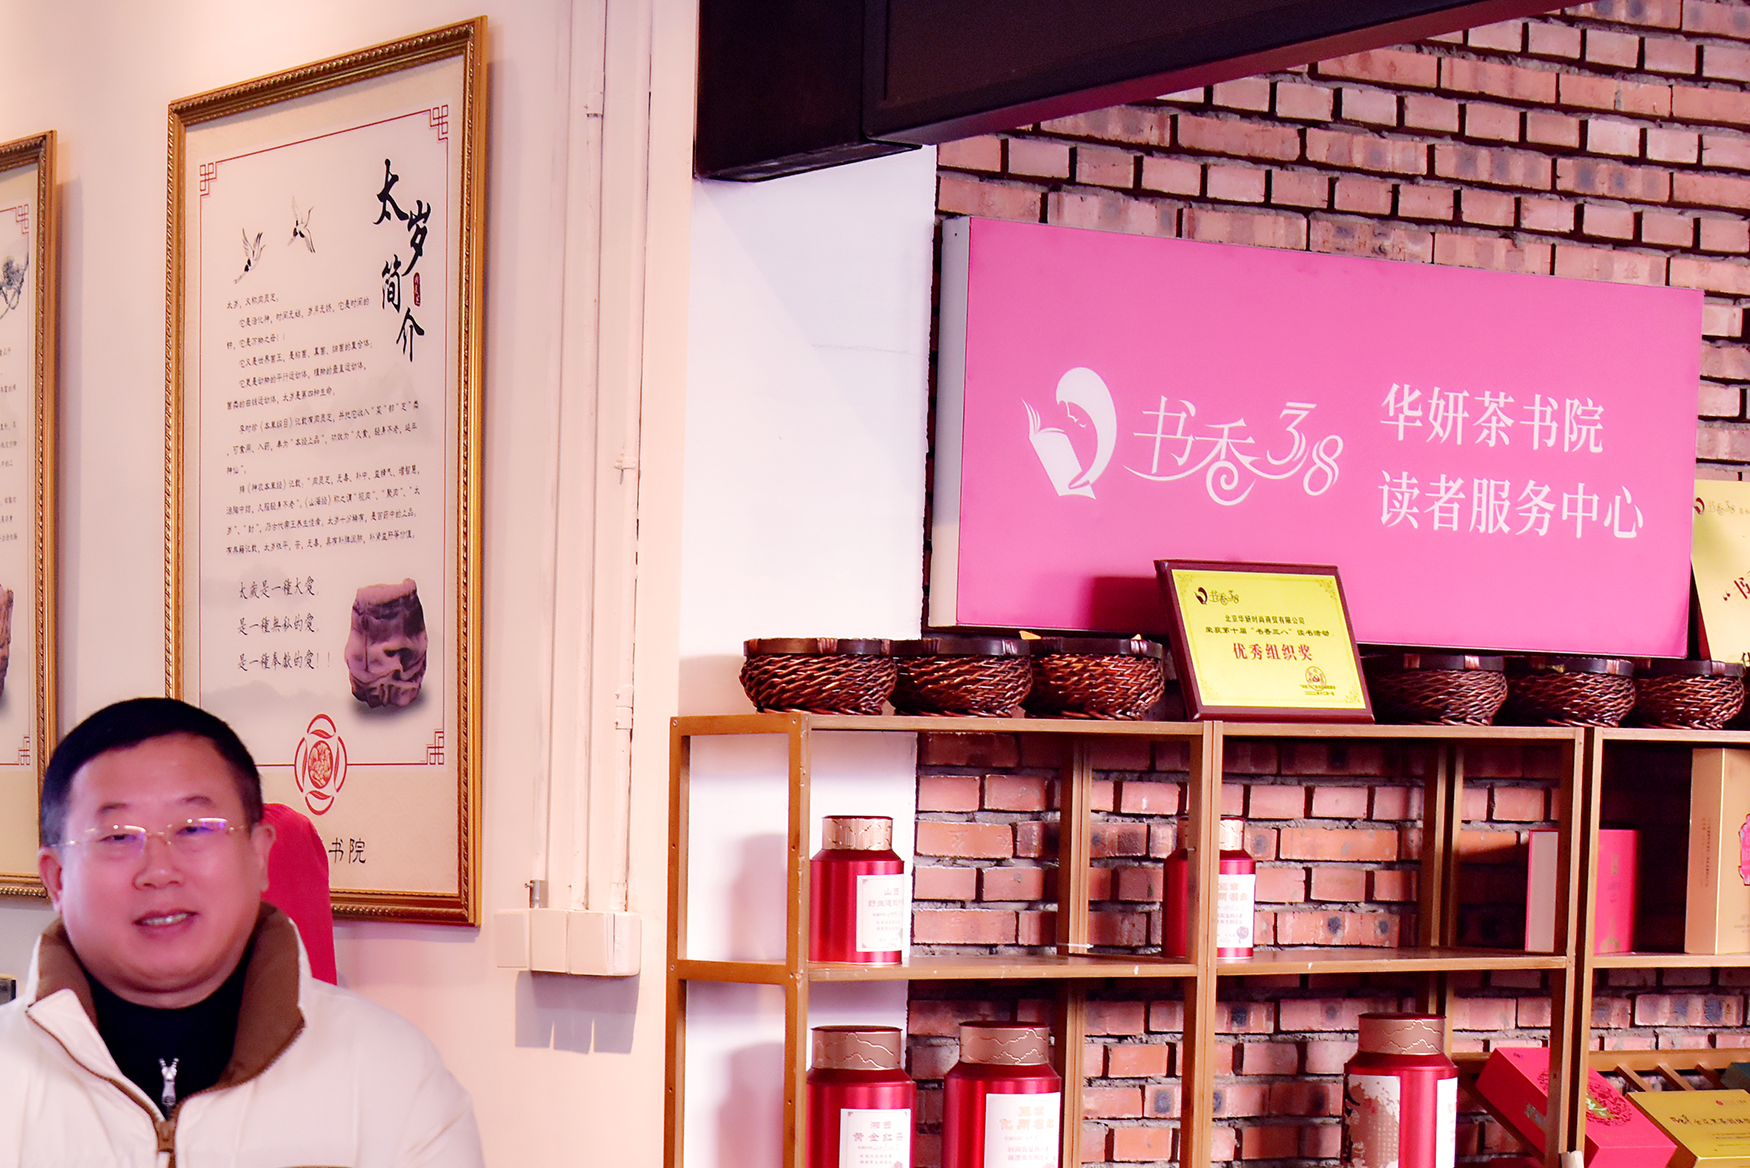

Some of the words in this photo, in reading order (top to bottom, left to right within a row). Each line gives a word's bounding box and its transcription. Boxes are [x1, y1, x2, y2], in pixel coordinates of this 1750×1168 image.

[372, 158, 431, 362] 太岁简介
[1380, 381, 1605, 454] 华妍茶书院
[1378, 469, 1644, 539] 读者服务中心
[1233, 642, 1313, 661] 优秀组织奖
